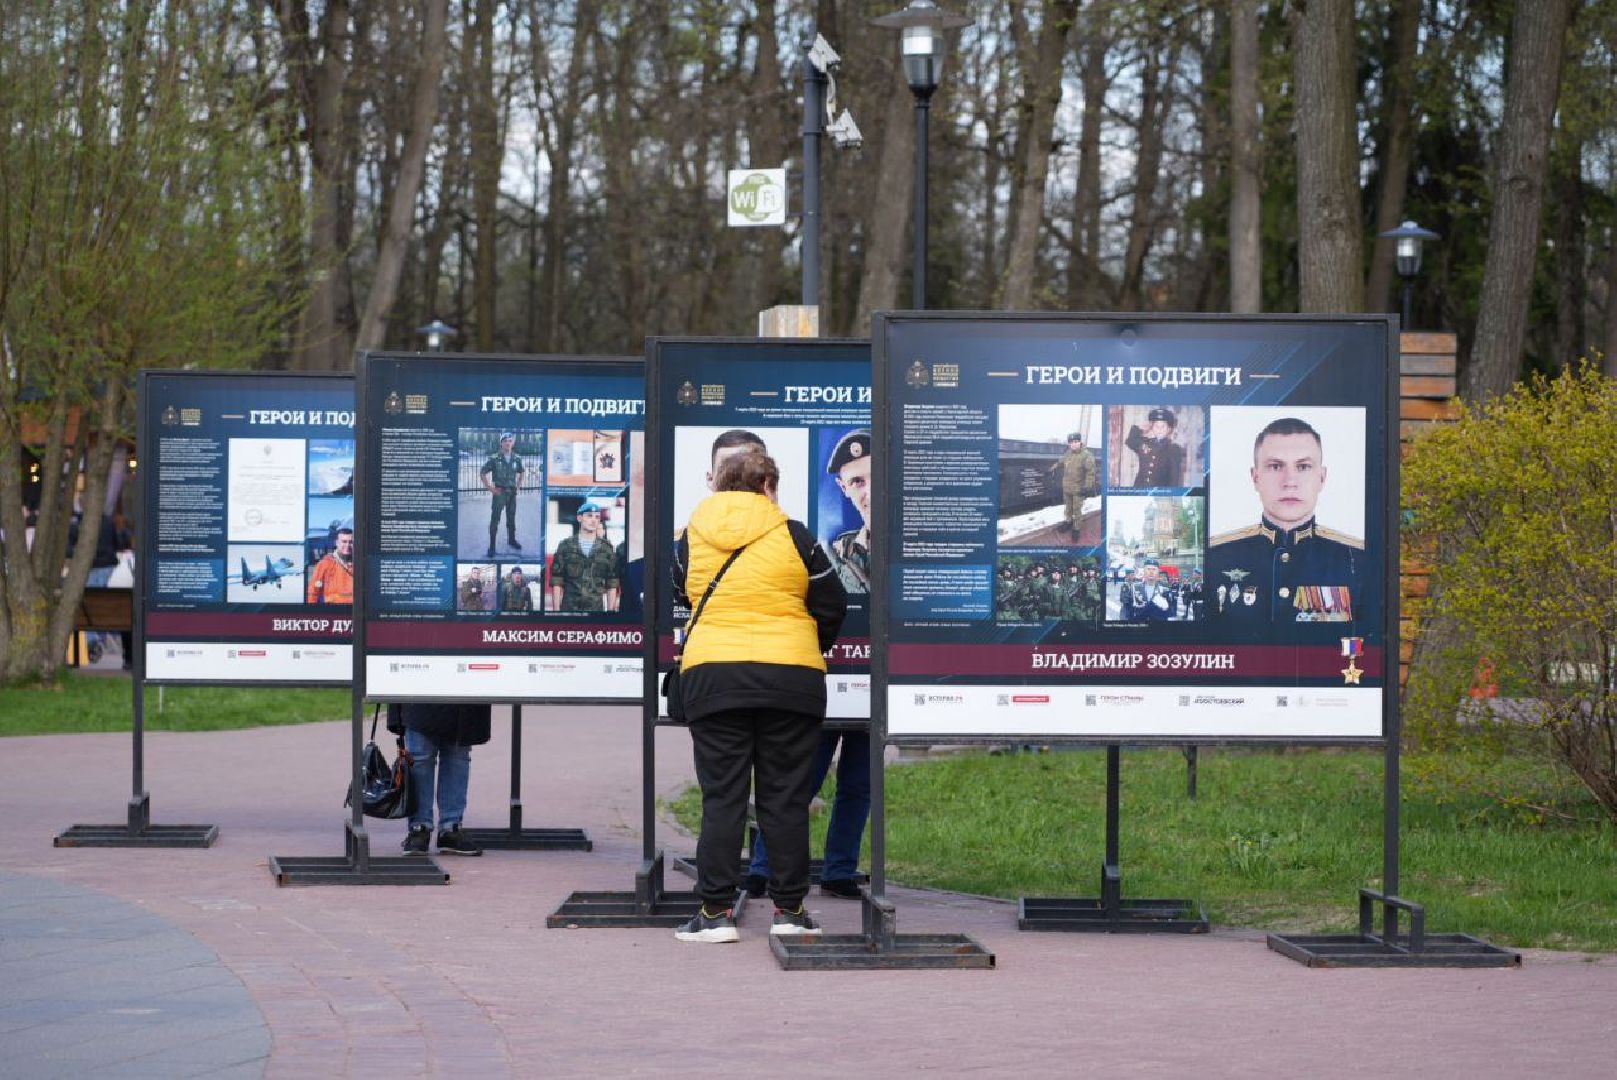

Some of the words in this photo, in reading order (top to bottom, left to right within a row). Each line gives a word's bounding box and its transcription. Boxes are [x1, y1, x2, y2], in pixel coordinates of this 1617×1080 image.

[1026, 365, 1101, 386] ГЕРОИ
[1106, 366, 1124, 386] И
[1129, 366, 1242, 390] ПОДВИГИ
[783, 386, 852, 403] ГЕРОИ
[481, 396, 542, 414] ГЕРОИ
[546, 398, 561, 415] И
[249, 410, 306, 425] ГЕРОИ
[308, 410, 323, 425] И
[271, 619, 329, 631] ВИКТОР
[332, 619, 354, 633] ДУ
[482, 630, 554, 643] МАКСИМ
[1031, 653, 1143, 671] ВЛАДИМИР
[1147, 653, 1236, 670] ЗОЗУЛИН
